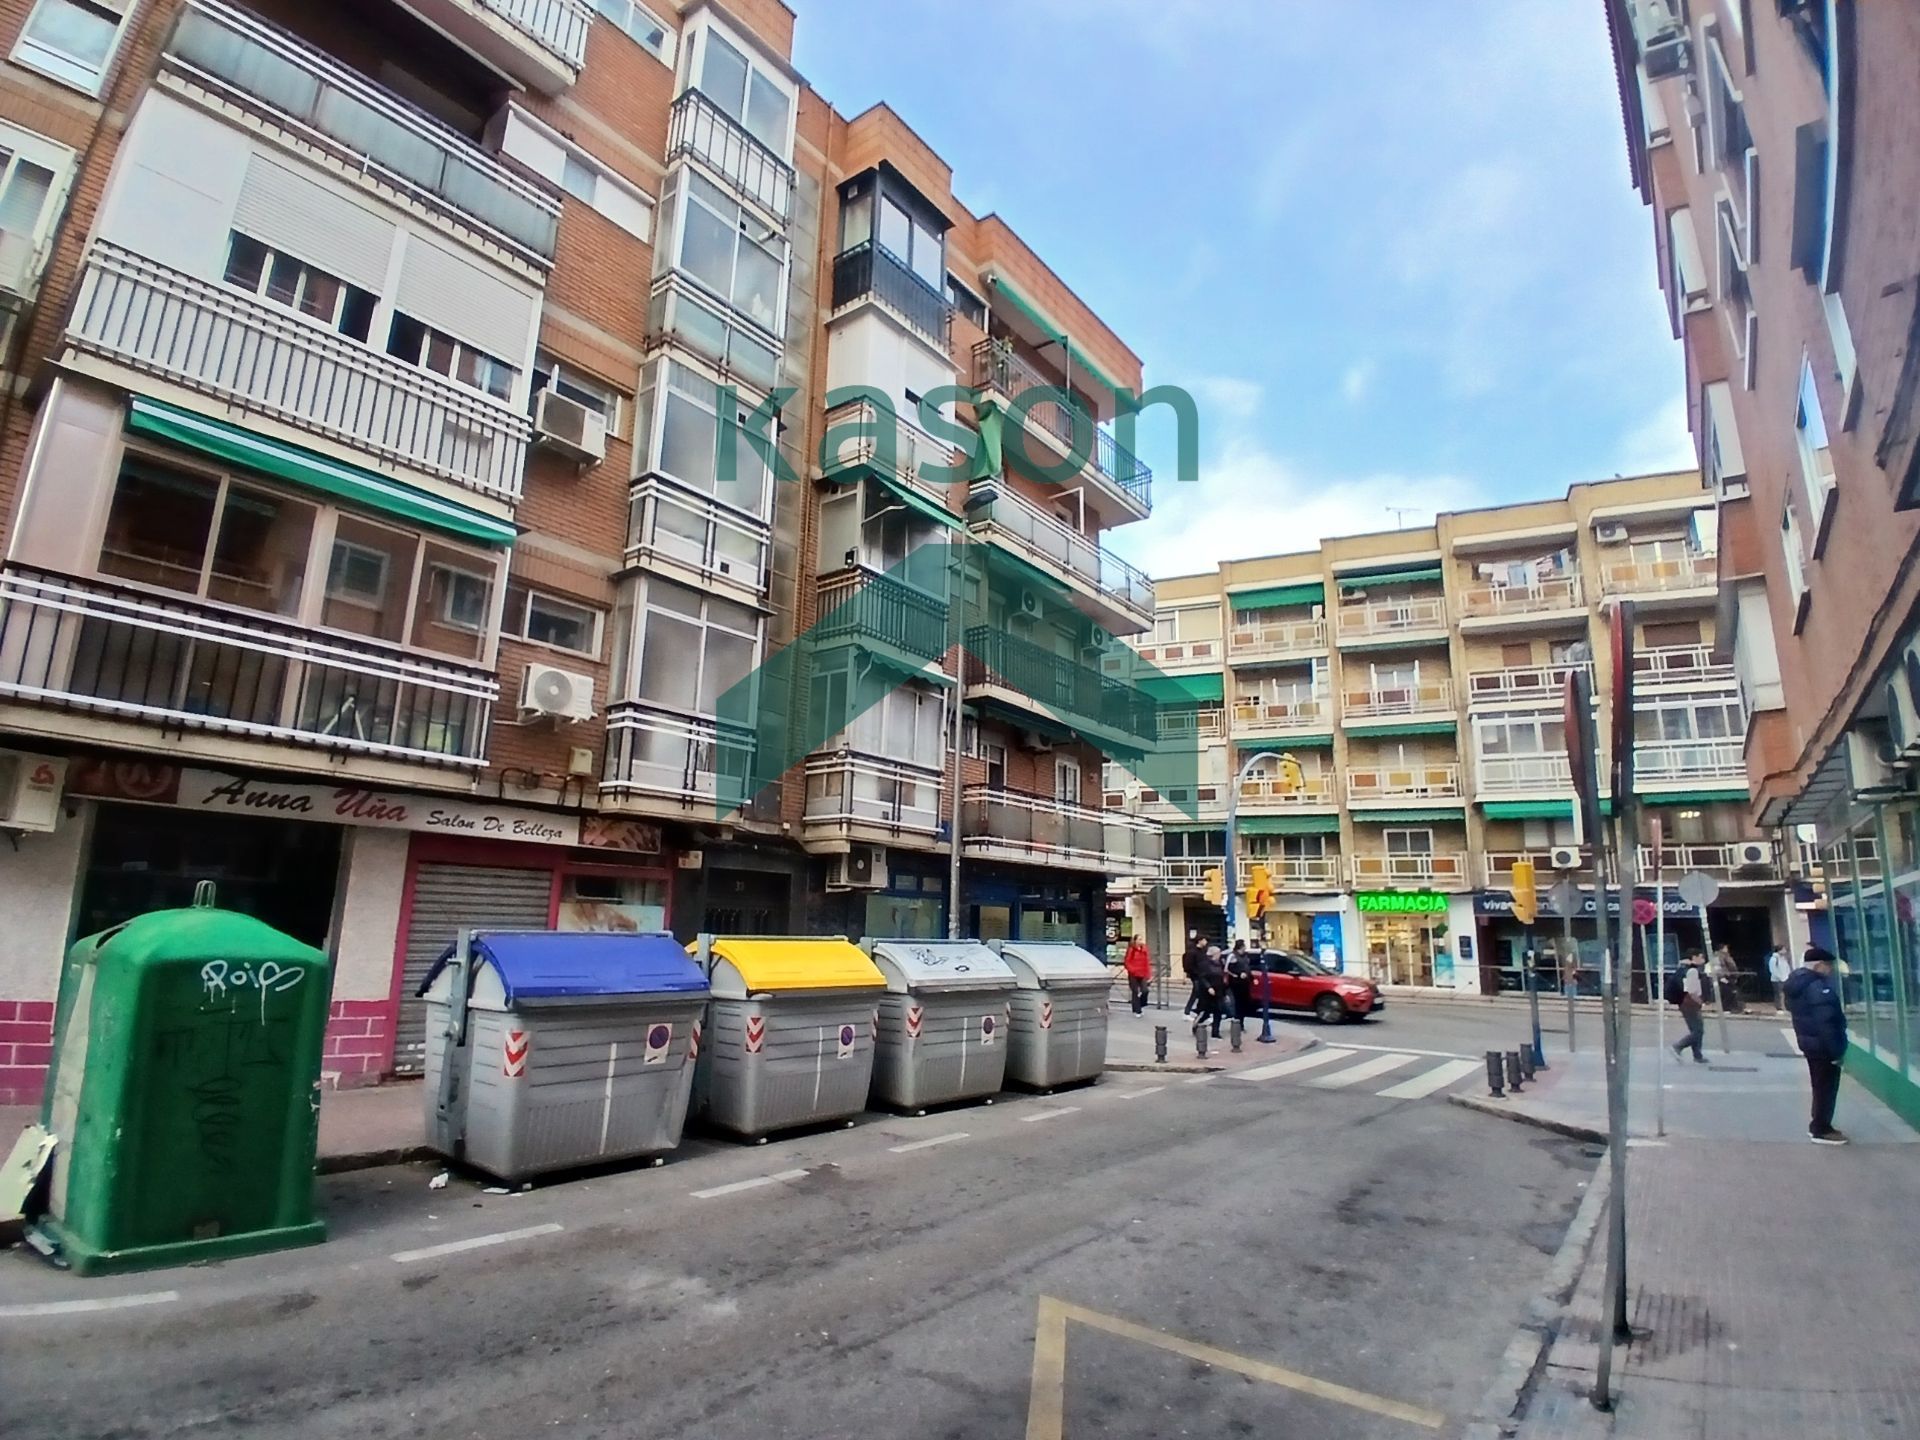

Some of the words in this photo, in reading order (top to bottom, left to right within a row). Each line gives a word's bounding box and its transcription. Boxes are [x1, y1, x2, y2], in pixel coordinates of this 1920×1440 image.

[202, 777, 314, 813] Anna
[426, 810, 476, 830] Salon
[483, 816, 505, 833] De
[512, 819, 563, 842] Belleza
[1358, 895, 1448, 912] FARMACIA
